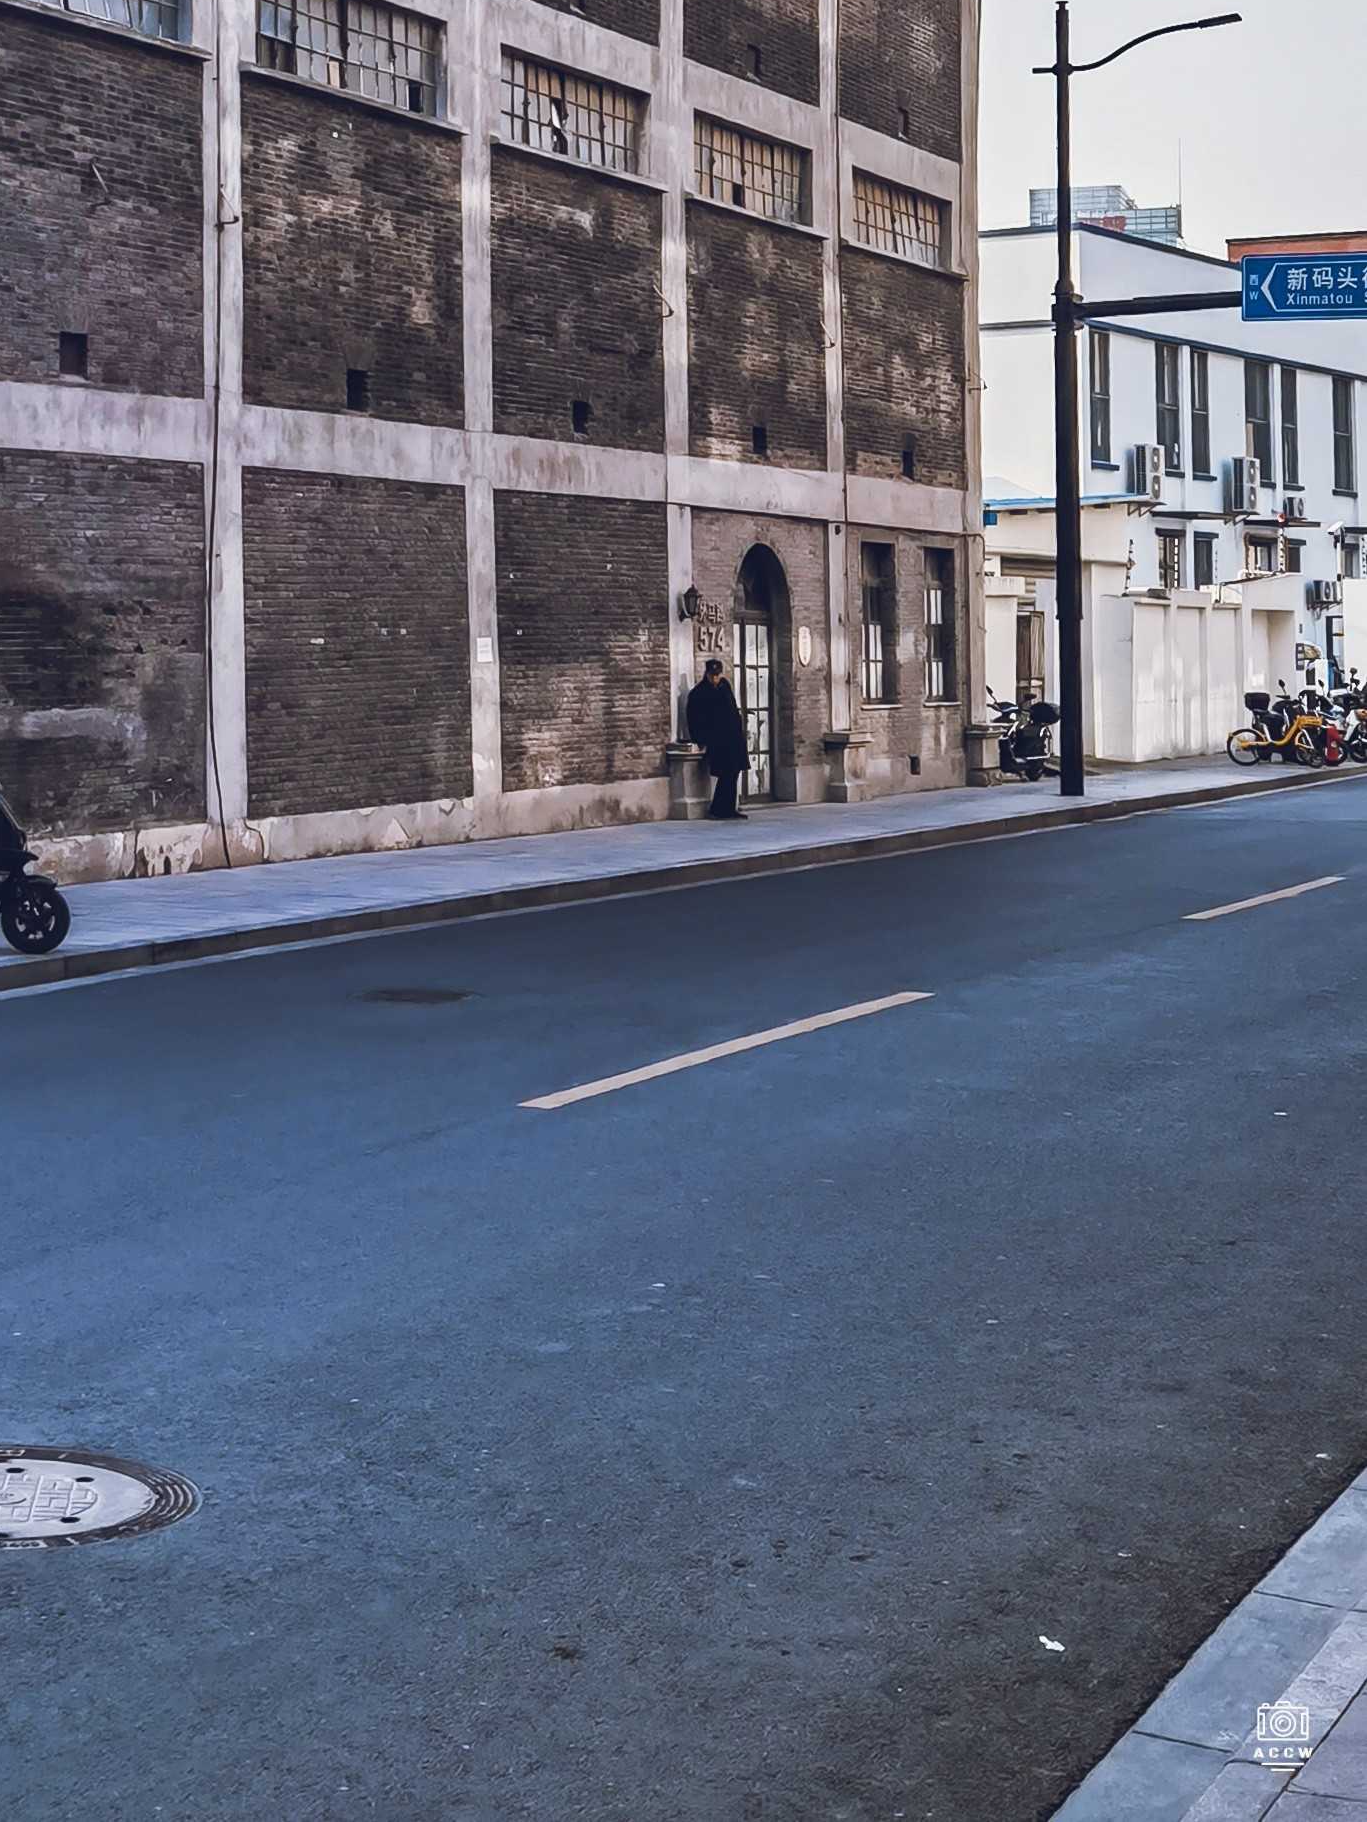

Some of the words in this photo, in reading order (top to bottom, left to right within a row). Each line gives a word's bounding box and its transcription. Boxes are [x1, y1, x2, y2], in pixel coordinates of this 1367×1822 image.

[1249, 291, 1259, 300] W
[1286, 292, 1353, 305] Xinmatou
[698, 625, 725, 652] 574
